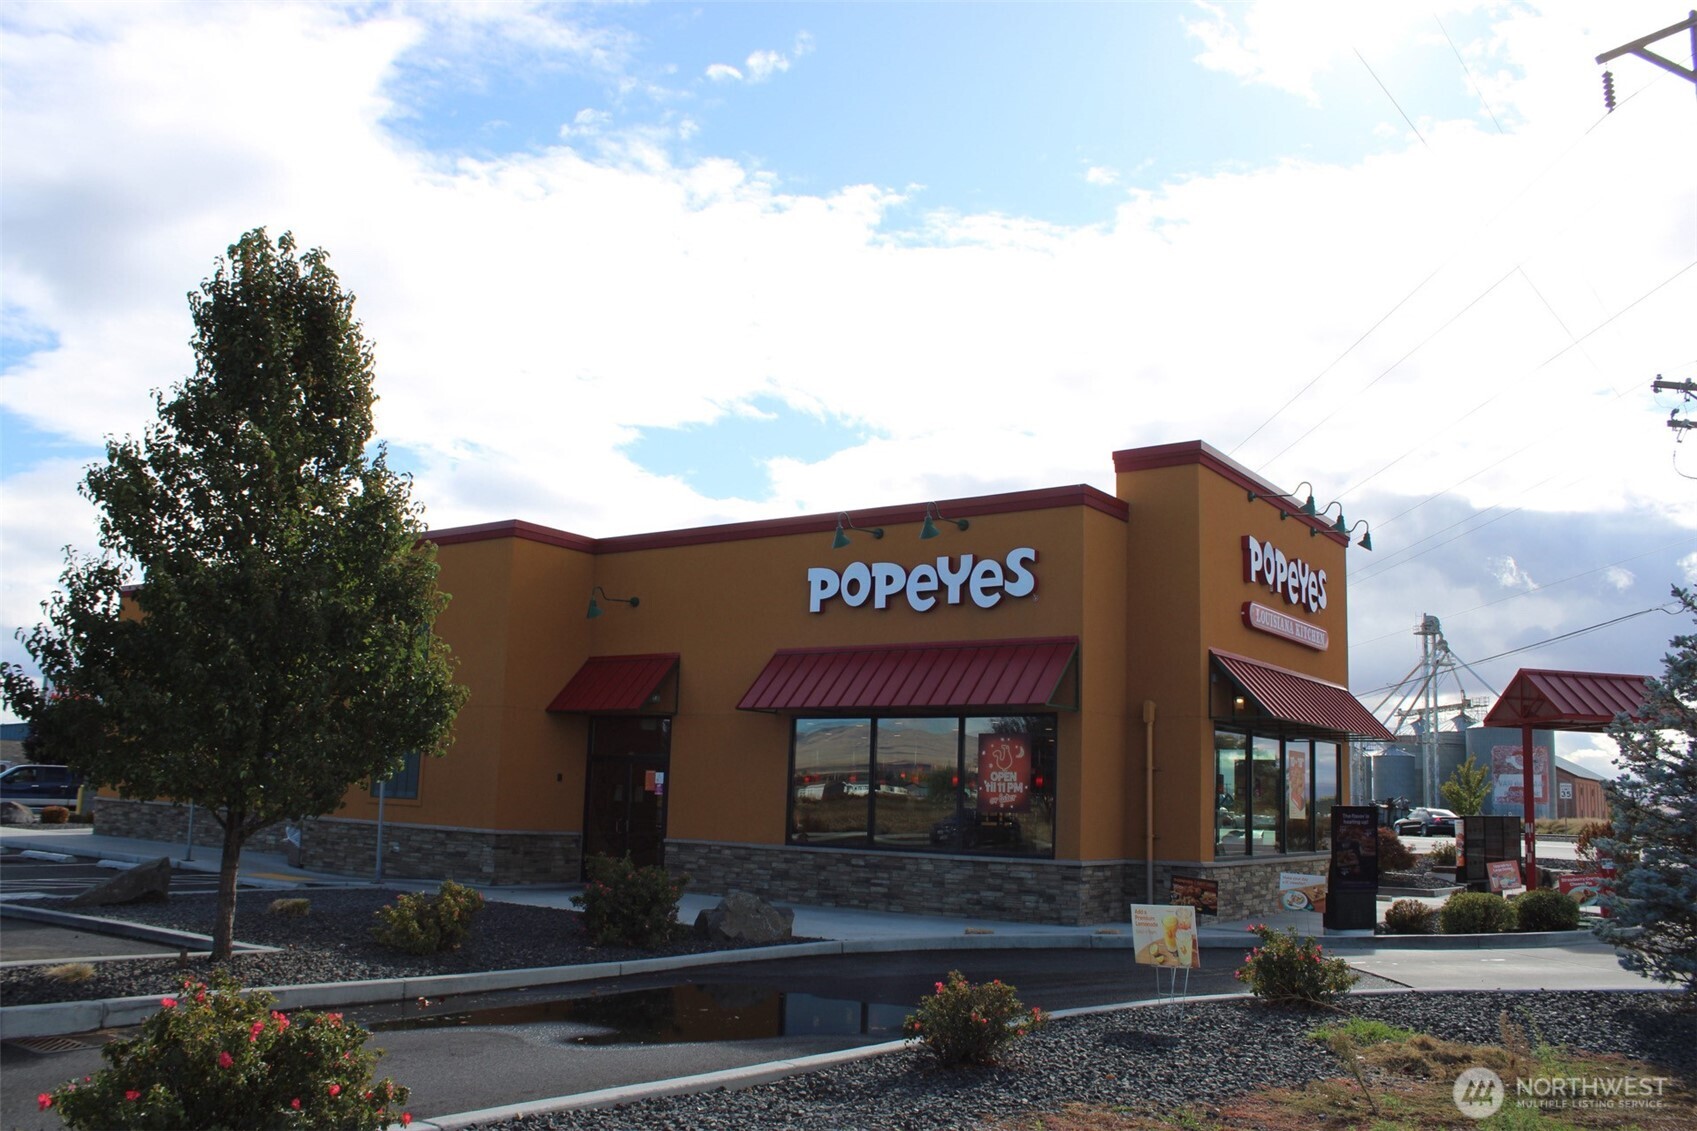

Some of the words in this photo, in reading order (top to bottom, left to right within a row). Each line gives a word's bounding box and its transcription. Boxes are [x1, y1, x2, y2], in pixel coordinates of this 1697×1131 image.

[1255, 608, 1294, 636] LOUISIANA
[1295, 621, 1325, 645] KITCHEN
[990, 772, 1017, 782] OPEN
[997, 782, 1006, 793] 11
[1007, 783, 1024, 793] PM
[1561, 790, 1571, 798] 35
